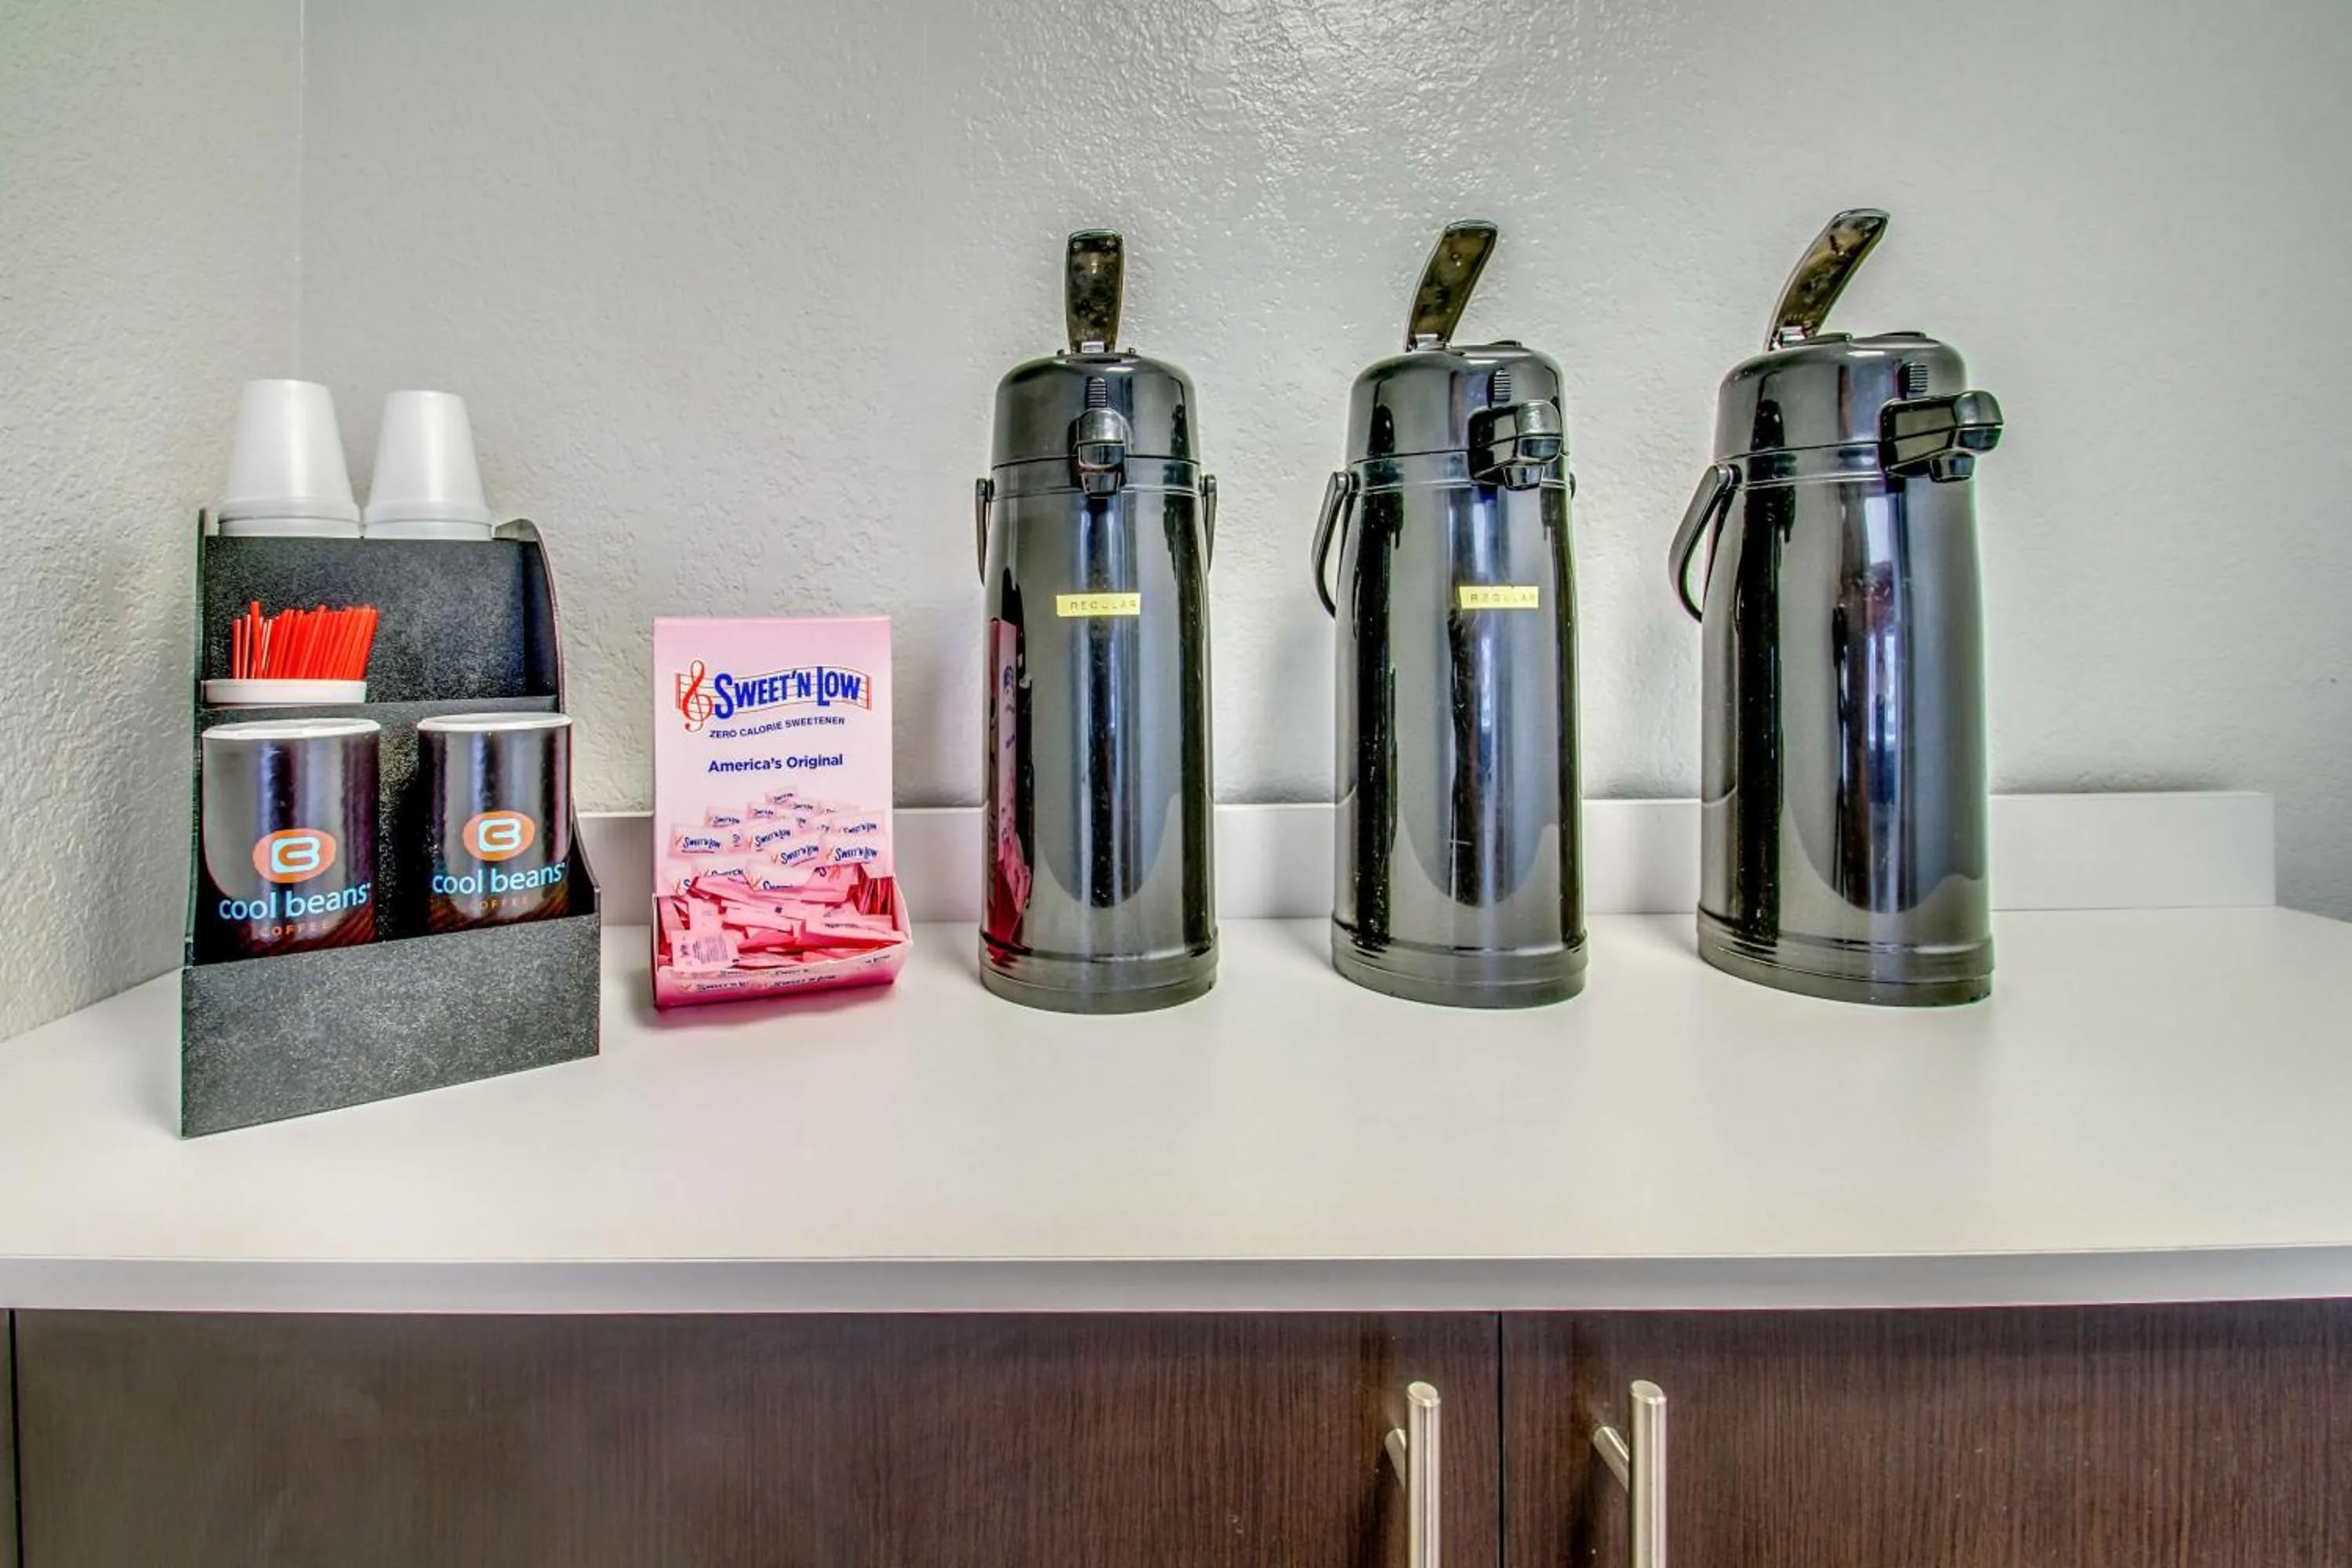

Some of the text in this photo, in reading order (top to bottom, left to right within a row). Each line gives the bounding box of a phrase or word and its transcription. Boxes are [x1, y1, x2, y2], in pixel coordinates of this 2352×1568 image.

[816, 666, 861, 706] LOW
[709, 715, 846, 739] ZERO CALORIE SWEETENER
[708, 753, 844, 773] America's Original
[432, 864, 564, 895] cool beans
[219, 885, 369, 920] cool beans
